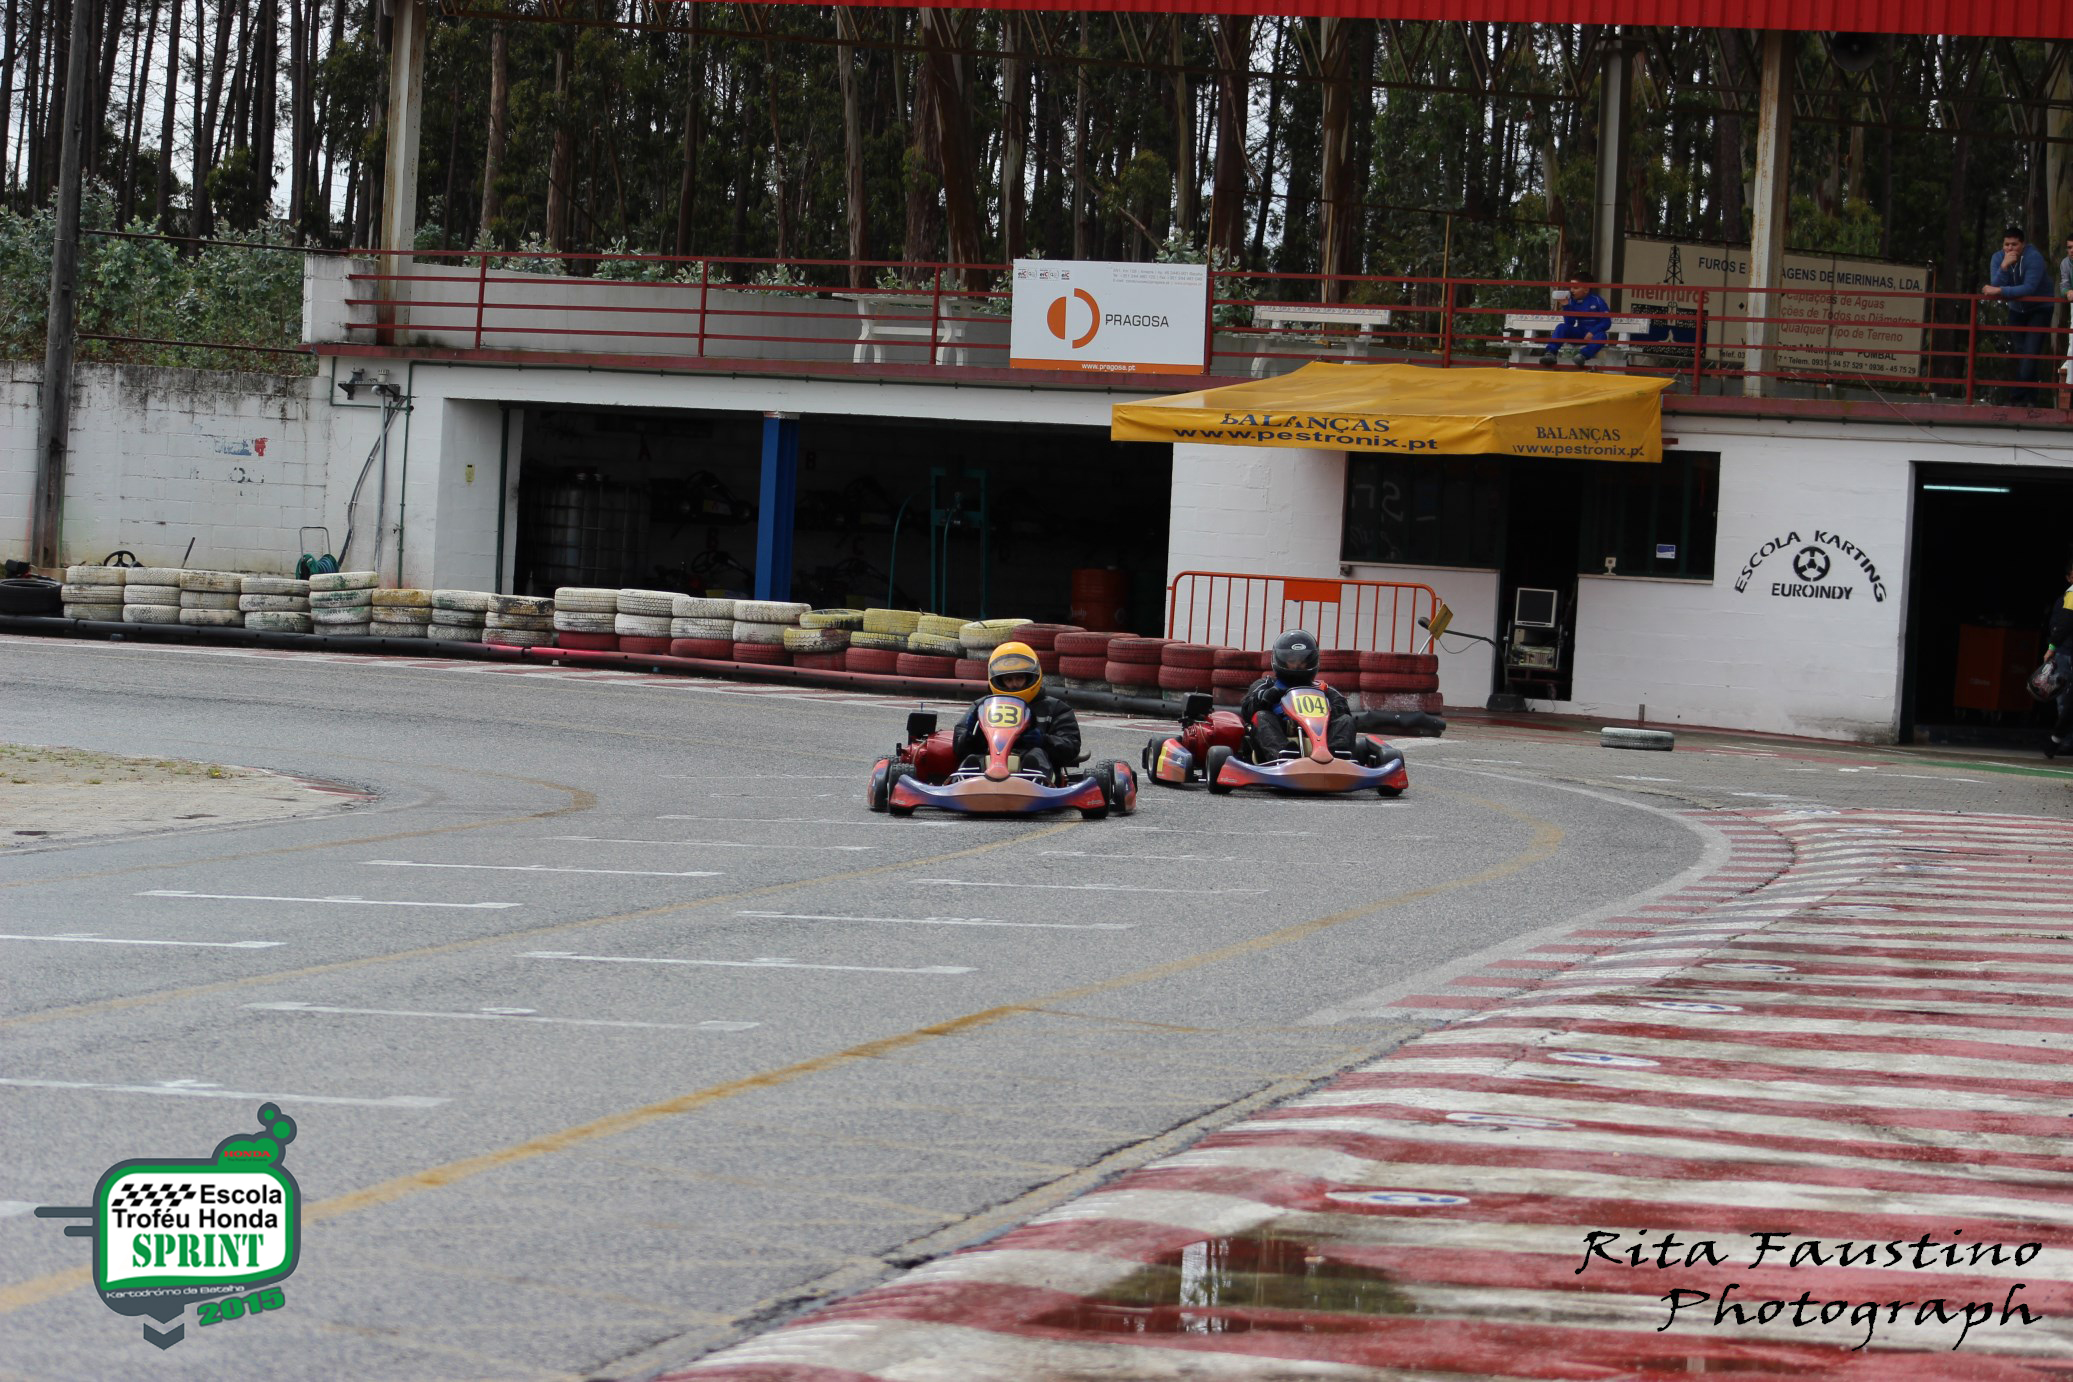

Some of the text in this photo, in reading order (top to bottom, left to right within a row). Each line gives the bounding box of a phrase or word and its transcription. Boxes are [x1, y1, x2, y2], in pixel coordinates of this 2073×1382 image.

[1698, 257, 1923, 291] FUROS E AGENS DE MEIRINHAS, LDA.
[1840, 296, 1852, 306] de
[1105, 314, 1169, 328] PRAGOSA
[1781, 305, 1804, 318] ções
[1806, 308, 1818, 318] de
[1822, 308, 1852, 321] Todos
[1854, 313, 1866, 322] os
[1781, 322, 1903, 342] Qualquer Tipo de Terreno
[1857, 350, 1897, 360] POMBAL
[1082, 362, 1136, 372] www.pragosa.pt
[1220, 413, 1390, 434] BALANÇAS
[1172, 428, 1438, 450] www.pestronix.pt
[1536, 426, 1622, 442] BALANÇAS
[1512, 444, 1645, 458] www.pestronix.pt
[1734, 530, 1887, 602] ESCOLA KARTING
[1771, 582, 1853, 600] EUROINDY
[1296, 696, 1326, 715] 104
[987, 705, 1019, 726] 63
